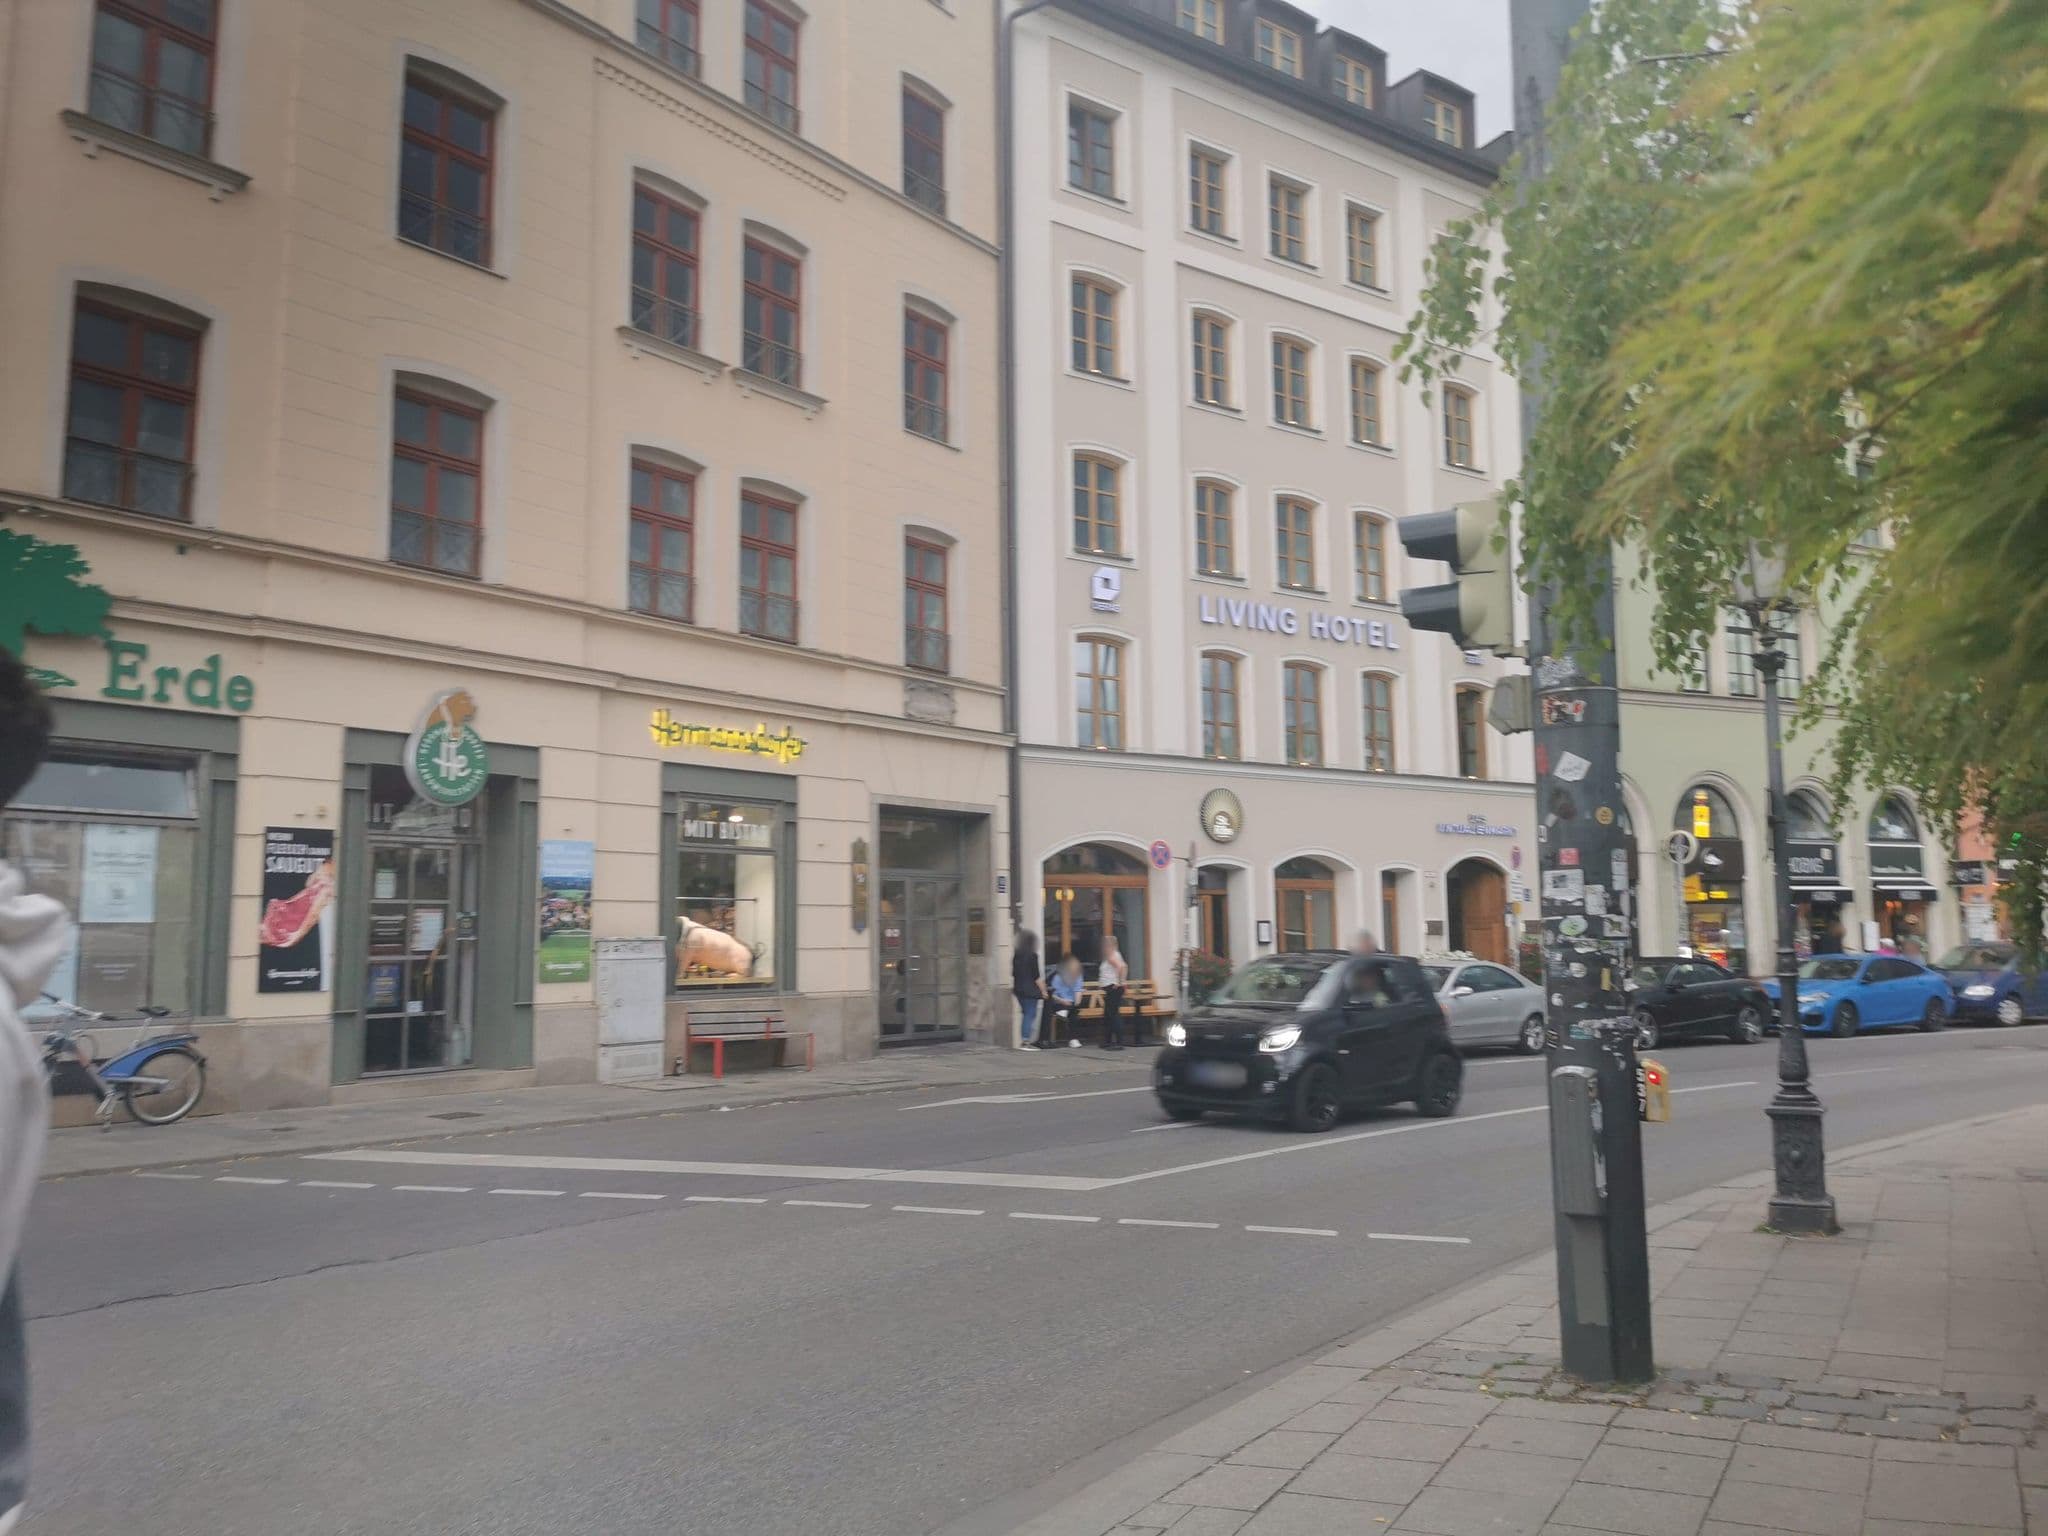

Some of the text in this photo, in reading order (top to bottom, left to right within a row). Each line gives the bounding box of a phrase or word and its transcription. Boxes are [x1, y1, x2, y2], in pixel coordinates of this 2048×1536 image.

[1199, 594, 1401, 651] LIVING HOTEL
[102, 639, 256, 713] Erde
